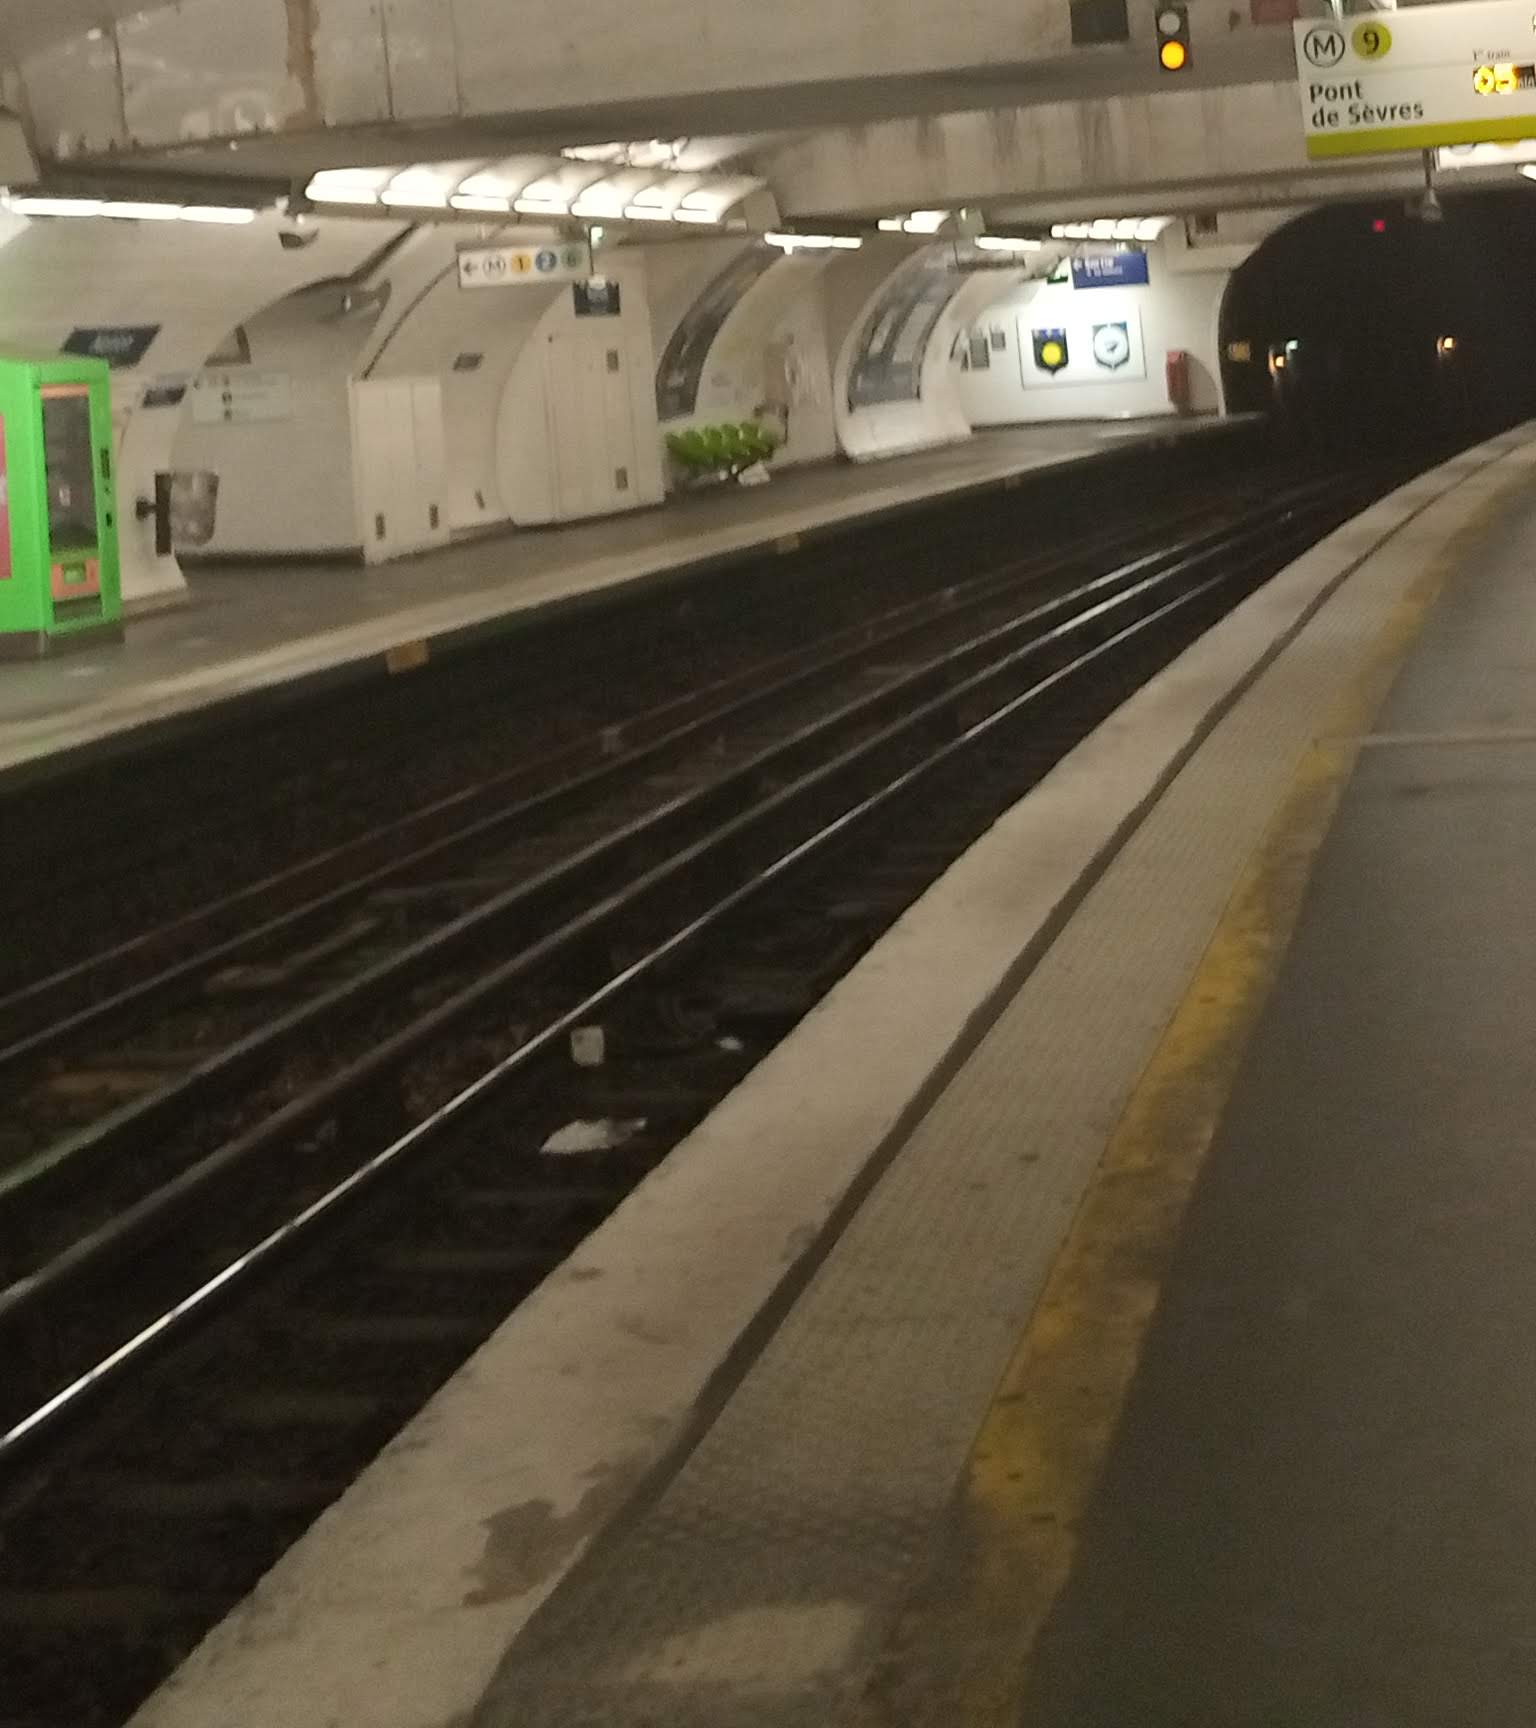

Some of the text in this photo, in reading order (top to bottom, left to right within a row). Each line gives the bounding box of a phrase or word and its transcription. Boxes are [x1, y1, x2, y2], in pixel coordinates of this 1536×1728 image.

[1362, 30, 1380, 55] 9
[1309, 79, 1363, 104] Pont
[1473, 63, 1519, 96] 05
[1312, 101, 1424, 128] de Sèvres
